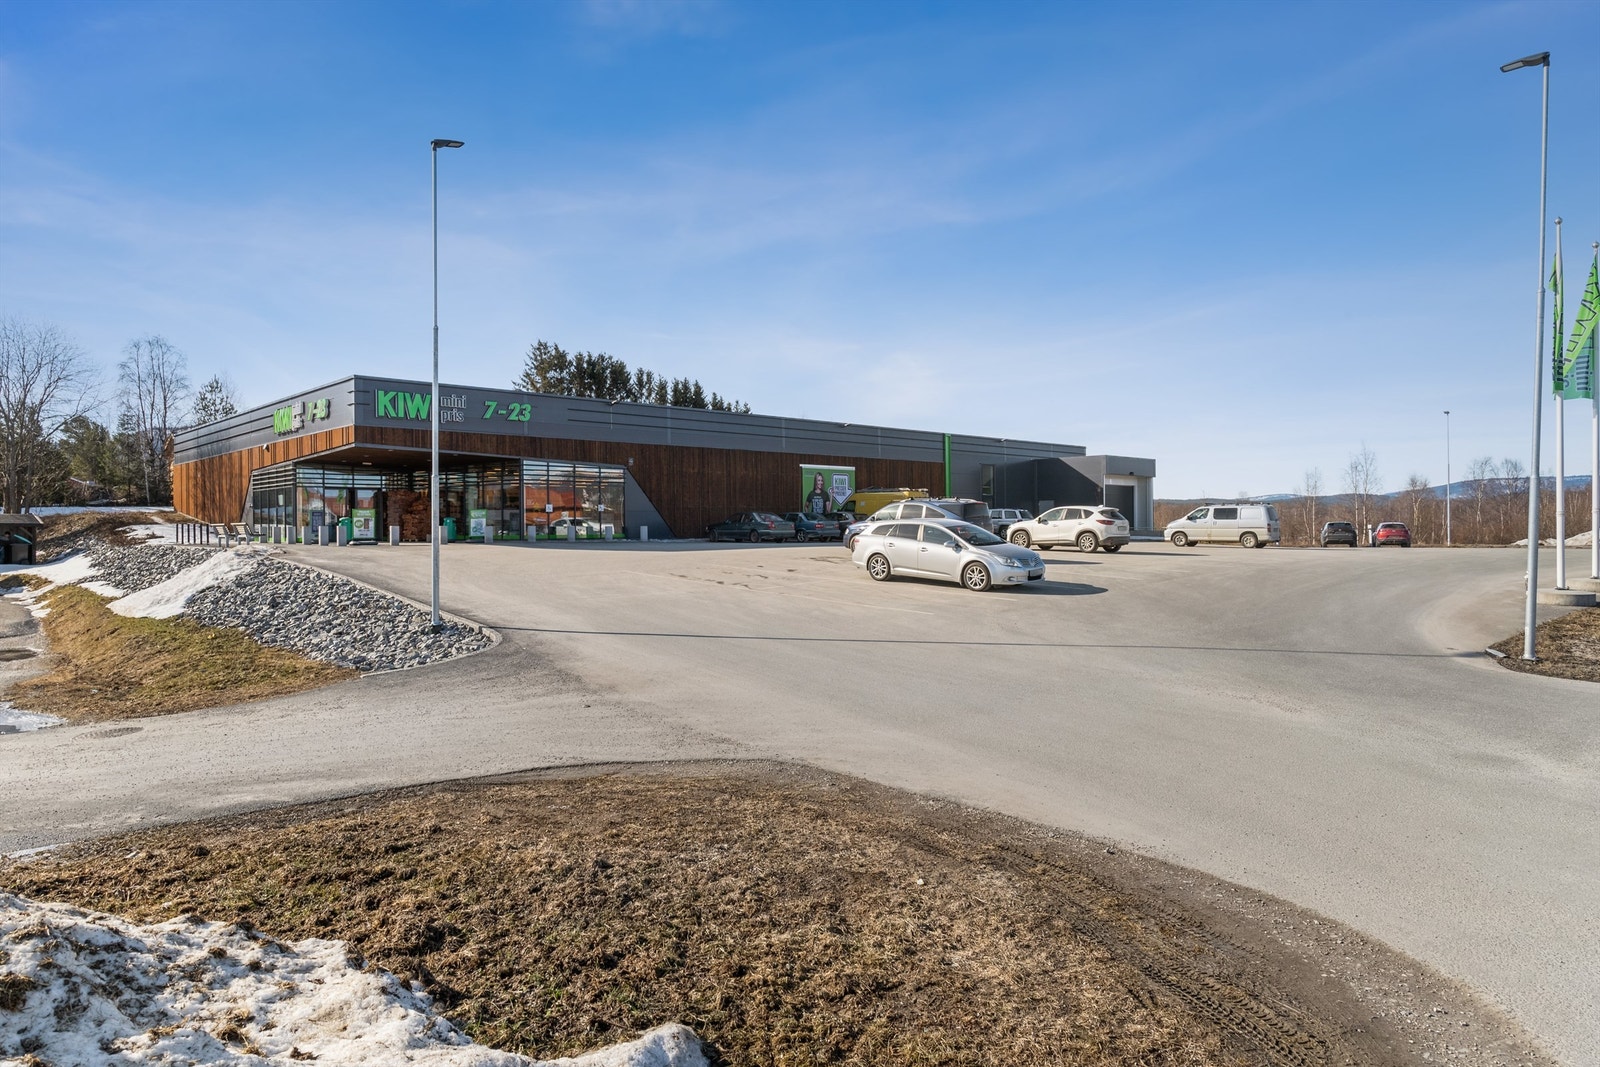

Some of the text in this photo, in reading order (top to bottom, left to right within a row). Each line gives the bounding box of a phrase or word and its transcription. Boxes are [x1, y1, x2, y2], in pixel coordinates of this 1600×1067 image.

[376, 389, 467, 421] KIW mini
[440, 408, 465, 424] pris
[482, 400, 532, 422] 7-23
